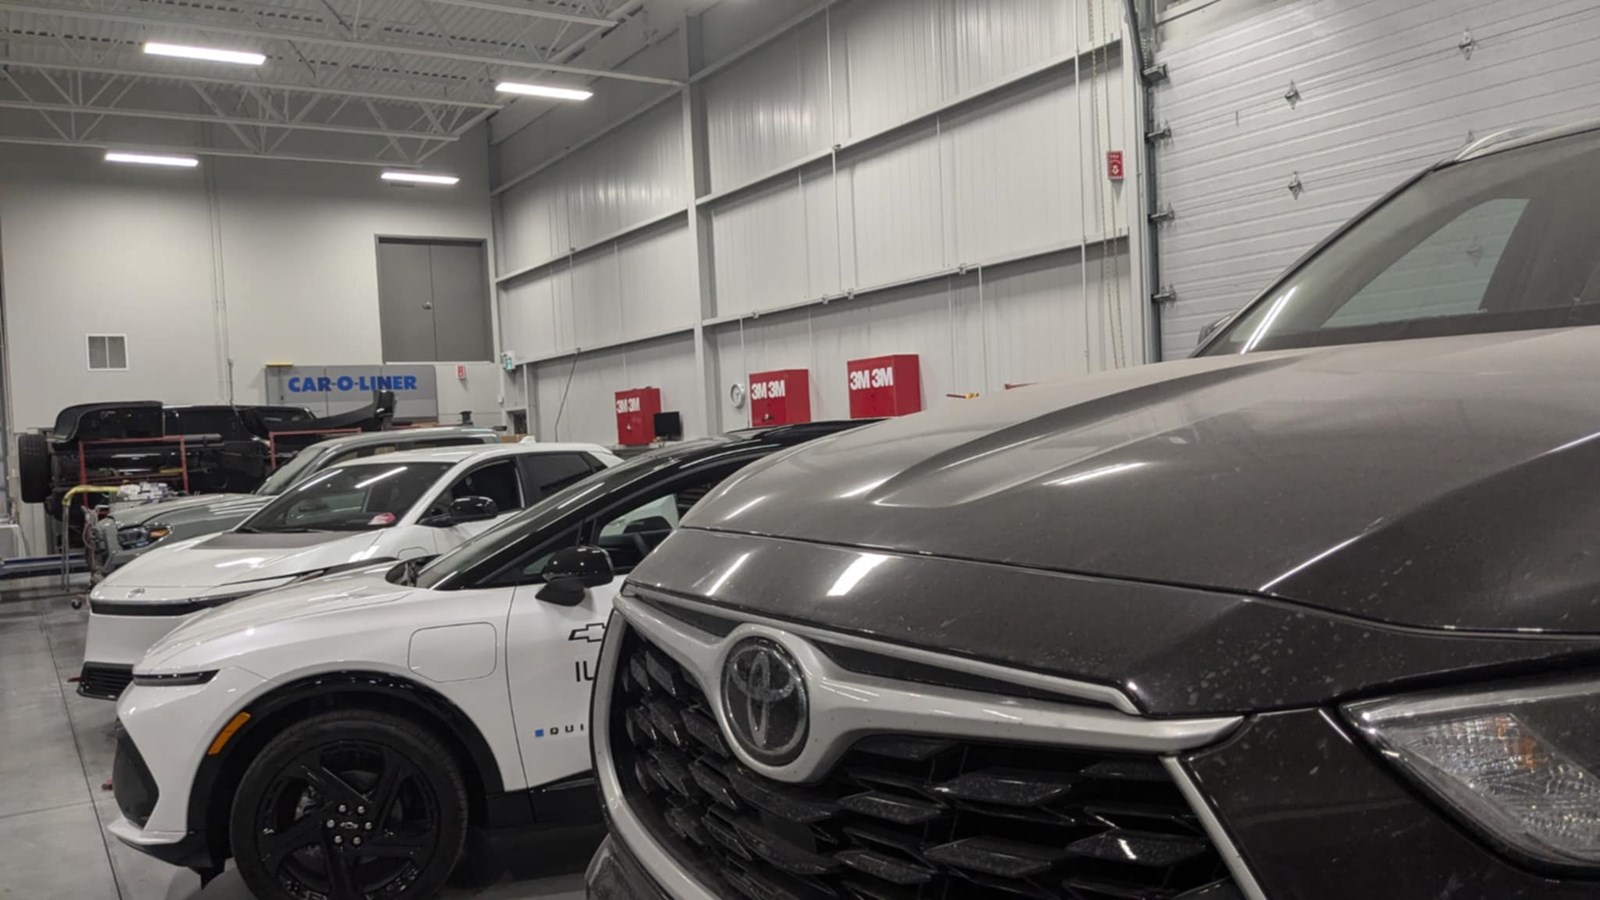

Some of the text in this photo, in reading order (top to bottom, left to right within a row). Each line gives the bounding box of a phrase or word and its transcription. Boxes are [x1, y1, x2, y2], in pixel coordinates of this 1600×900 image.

[288, 375, 417, 393] CAR-O-LINER
[850, 366, 894, 391] 3M 3M
[751, 379, 786, 400] 3M 3M
[628, 397, 641, 412] 3M
